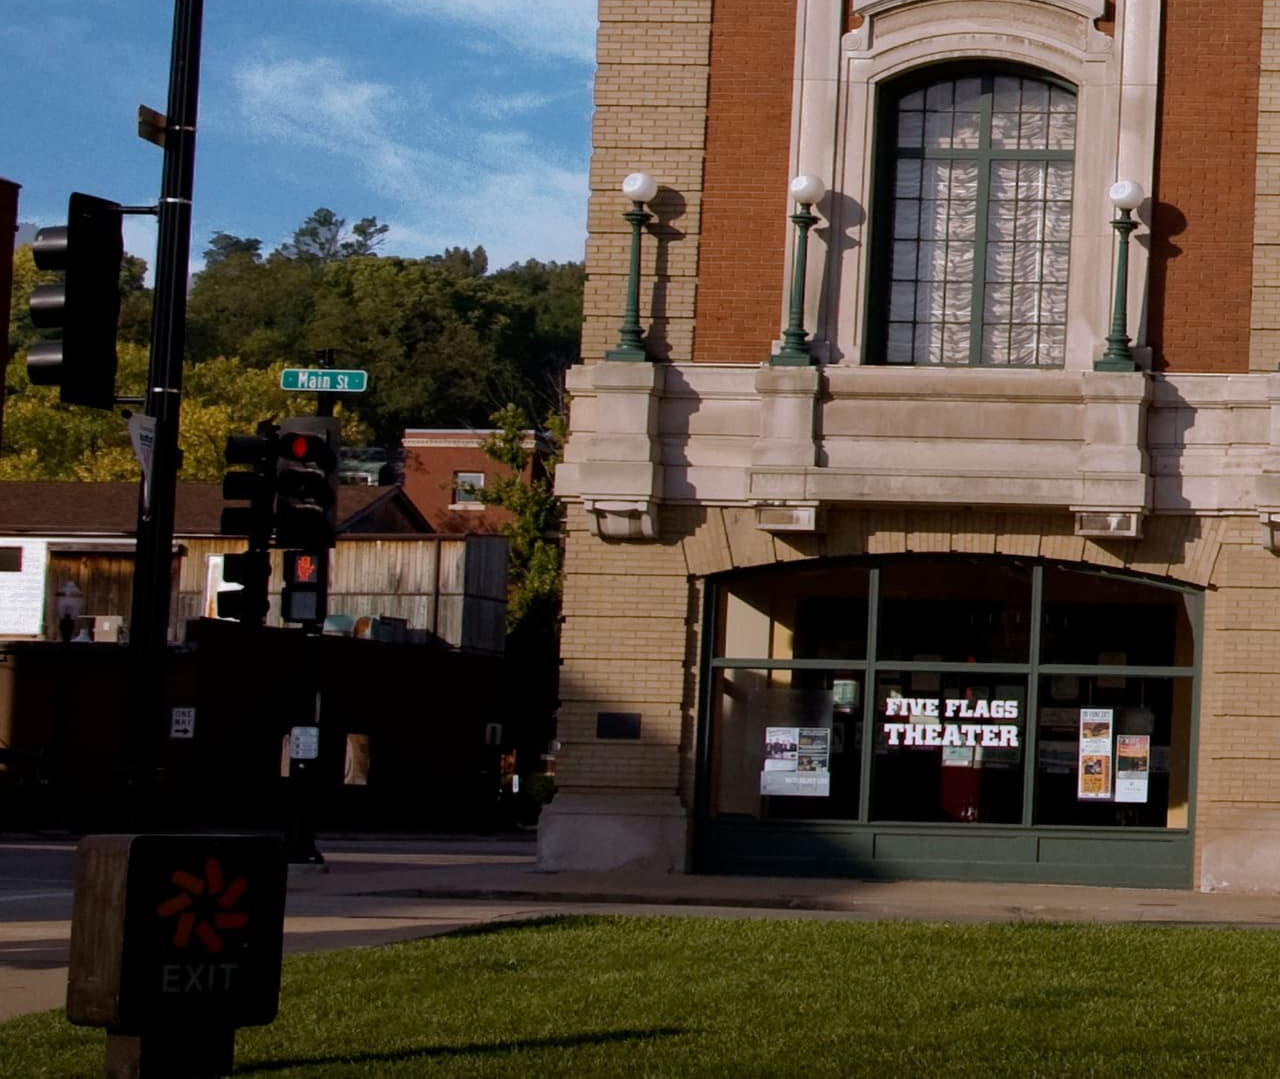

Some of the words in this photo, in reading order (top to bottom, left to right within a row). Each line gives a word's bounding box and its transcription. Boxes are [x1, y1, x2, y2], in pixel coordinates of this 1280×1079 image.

[297, 372, 330, 389] Main
[336, 374, 349, 389] St
[176, 710, 192, 718] ONE
[885, 697, 939, 717] FIVE
[944, 699, 1019, 719] FLAGS
[883, 723, 1019, 747] THEATER
[161, 962, 240, 993] EXIT
